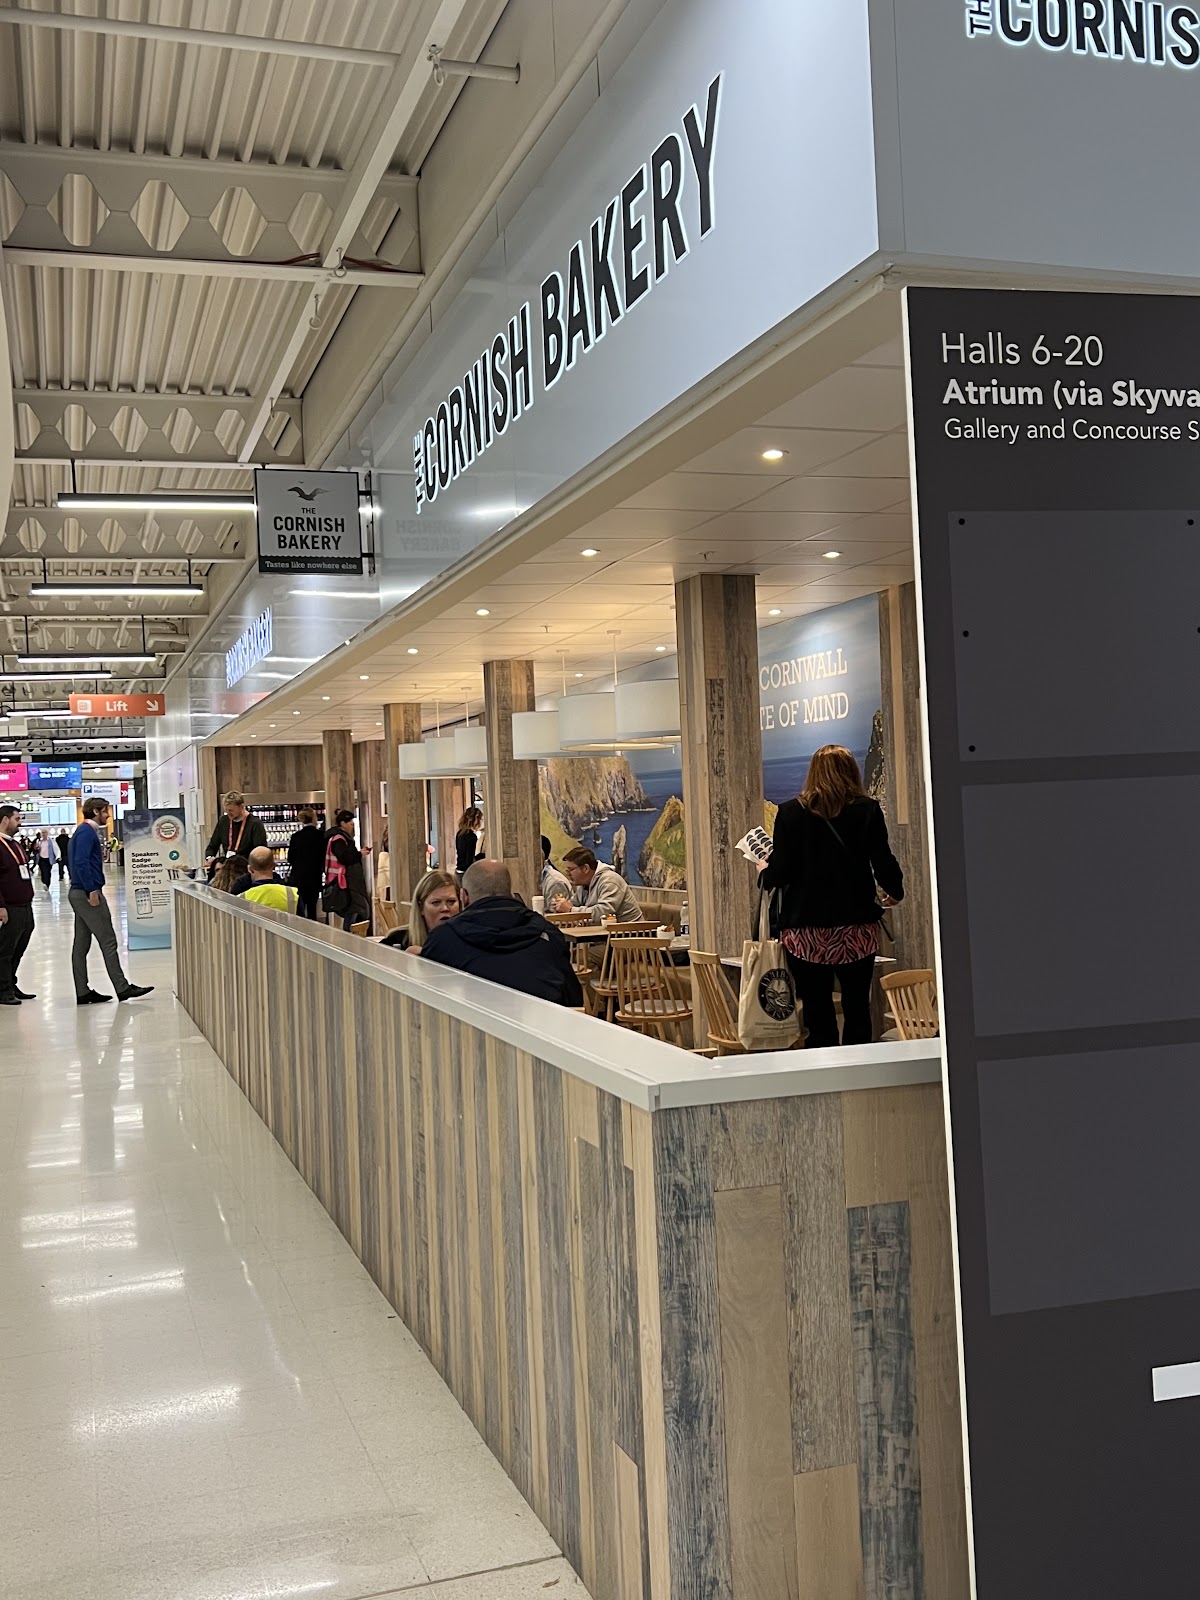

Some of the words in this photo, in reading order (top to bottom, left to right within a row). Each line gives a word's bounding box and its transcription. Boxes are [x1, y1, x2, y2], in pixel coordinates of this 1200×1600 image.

[997, 0, 1200, 69] CORNIS
[413, 429, 425, 515] THE
[422, 301, 533, 503] CORNISH
[540, 70, 725, 392] BAKERY
[941, 332, 1021, 365] Halls
[1031, 335, 1104, 366] 6-20
[942, 378, 1043, 405] Atrium
[1053, 379, 1103, 410] (via
[1112, 380, 1200, 414] Skywa
[944, 418, 1020, 444] Gallery
[1027, 418, 1065, 439] and
[1072, 419, 1182, 440] Concourse
[273, 516, 345, 532] CORNISH
[277, 534, 342, 550] BAKERY
[291, 561, 305, 569] like
[760, 648, 848, 690] CORNWALL
[105, 700, 128, 711] Lift
[779, 700, 799, 727] OF
[803, 691, 849, 723] MIND
